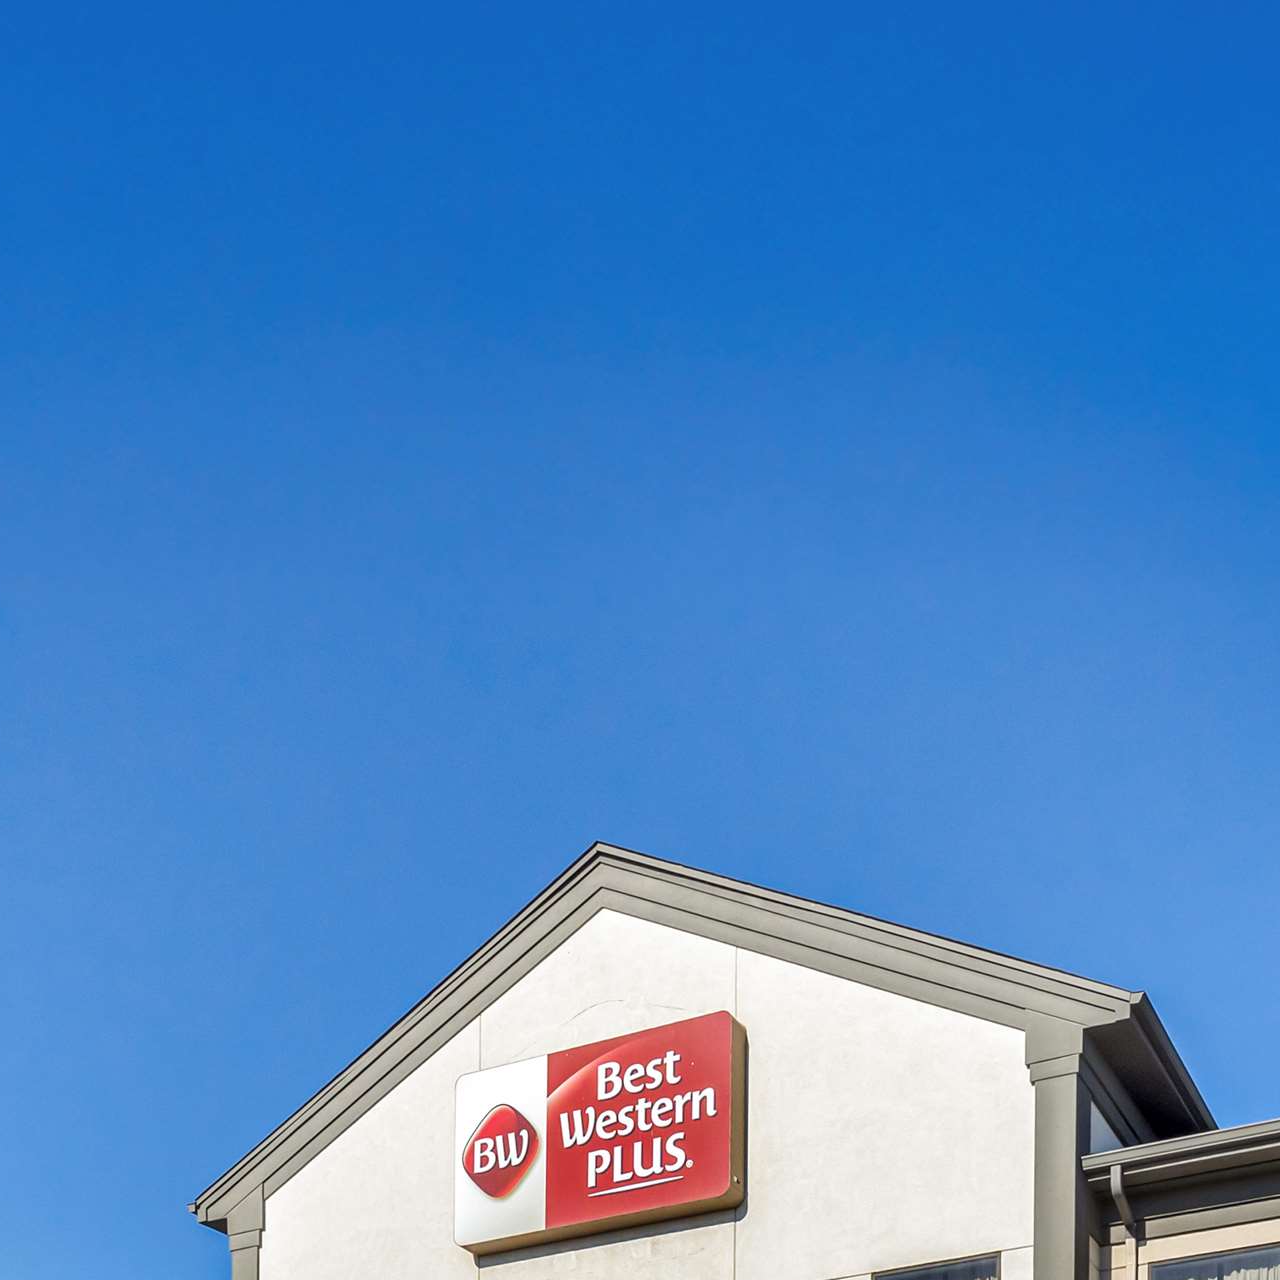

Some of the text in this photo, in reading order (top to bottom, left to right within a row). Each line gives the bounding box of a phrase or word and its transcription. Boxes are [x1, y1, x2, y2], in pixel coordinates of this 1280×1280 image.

[596, 1050, 681, 1101] Best
[559, 1087, 718, 1148] Western
[473, 1129, 529, 1174] BW
